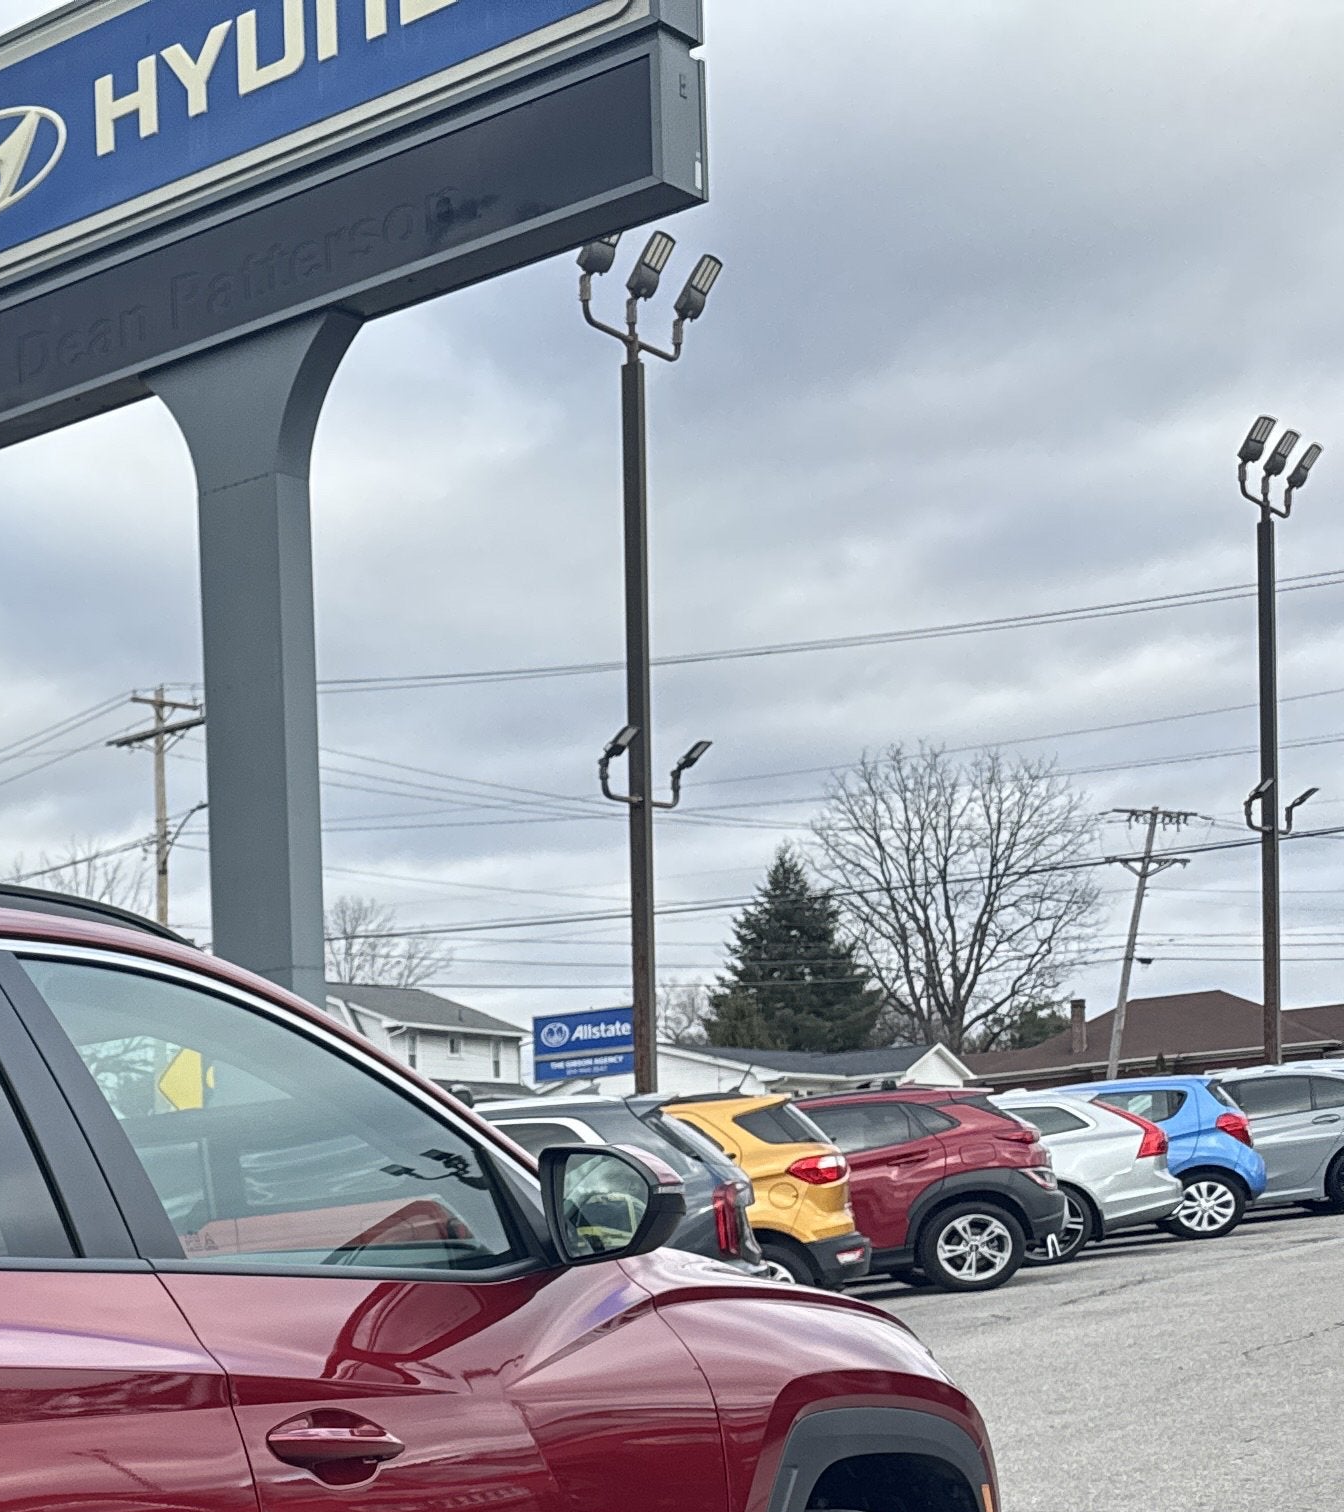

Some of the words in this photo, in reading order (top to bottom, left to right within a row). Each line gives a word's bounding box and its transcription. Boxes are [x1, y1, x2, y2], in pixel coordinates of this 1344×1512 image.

[94, 0, 457, 157] HYUN
[17, 301, 148, 383] Dean
[571, 1020, 631, 1041] Allstate
